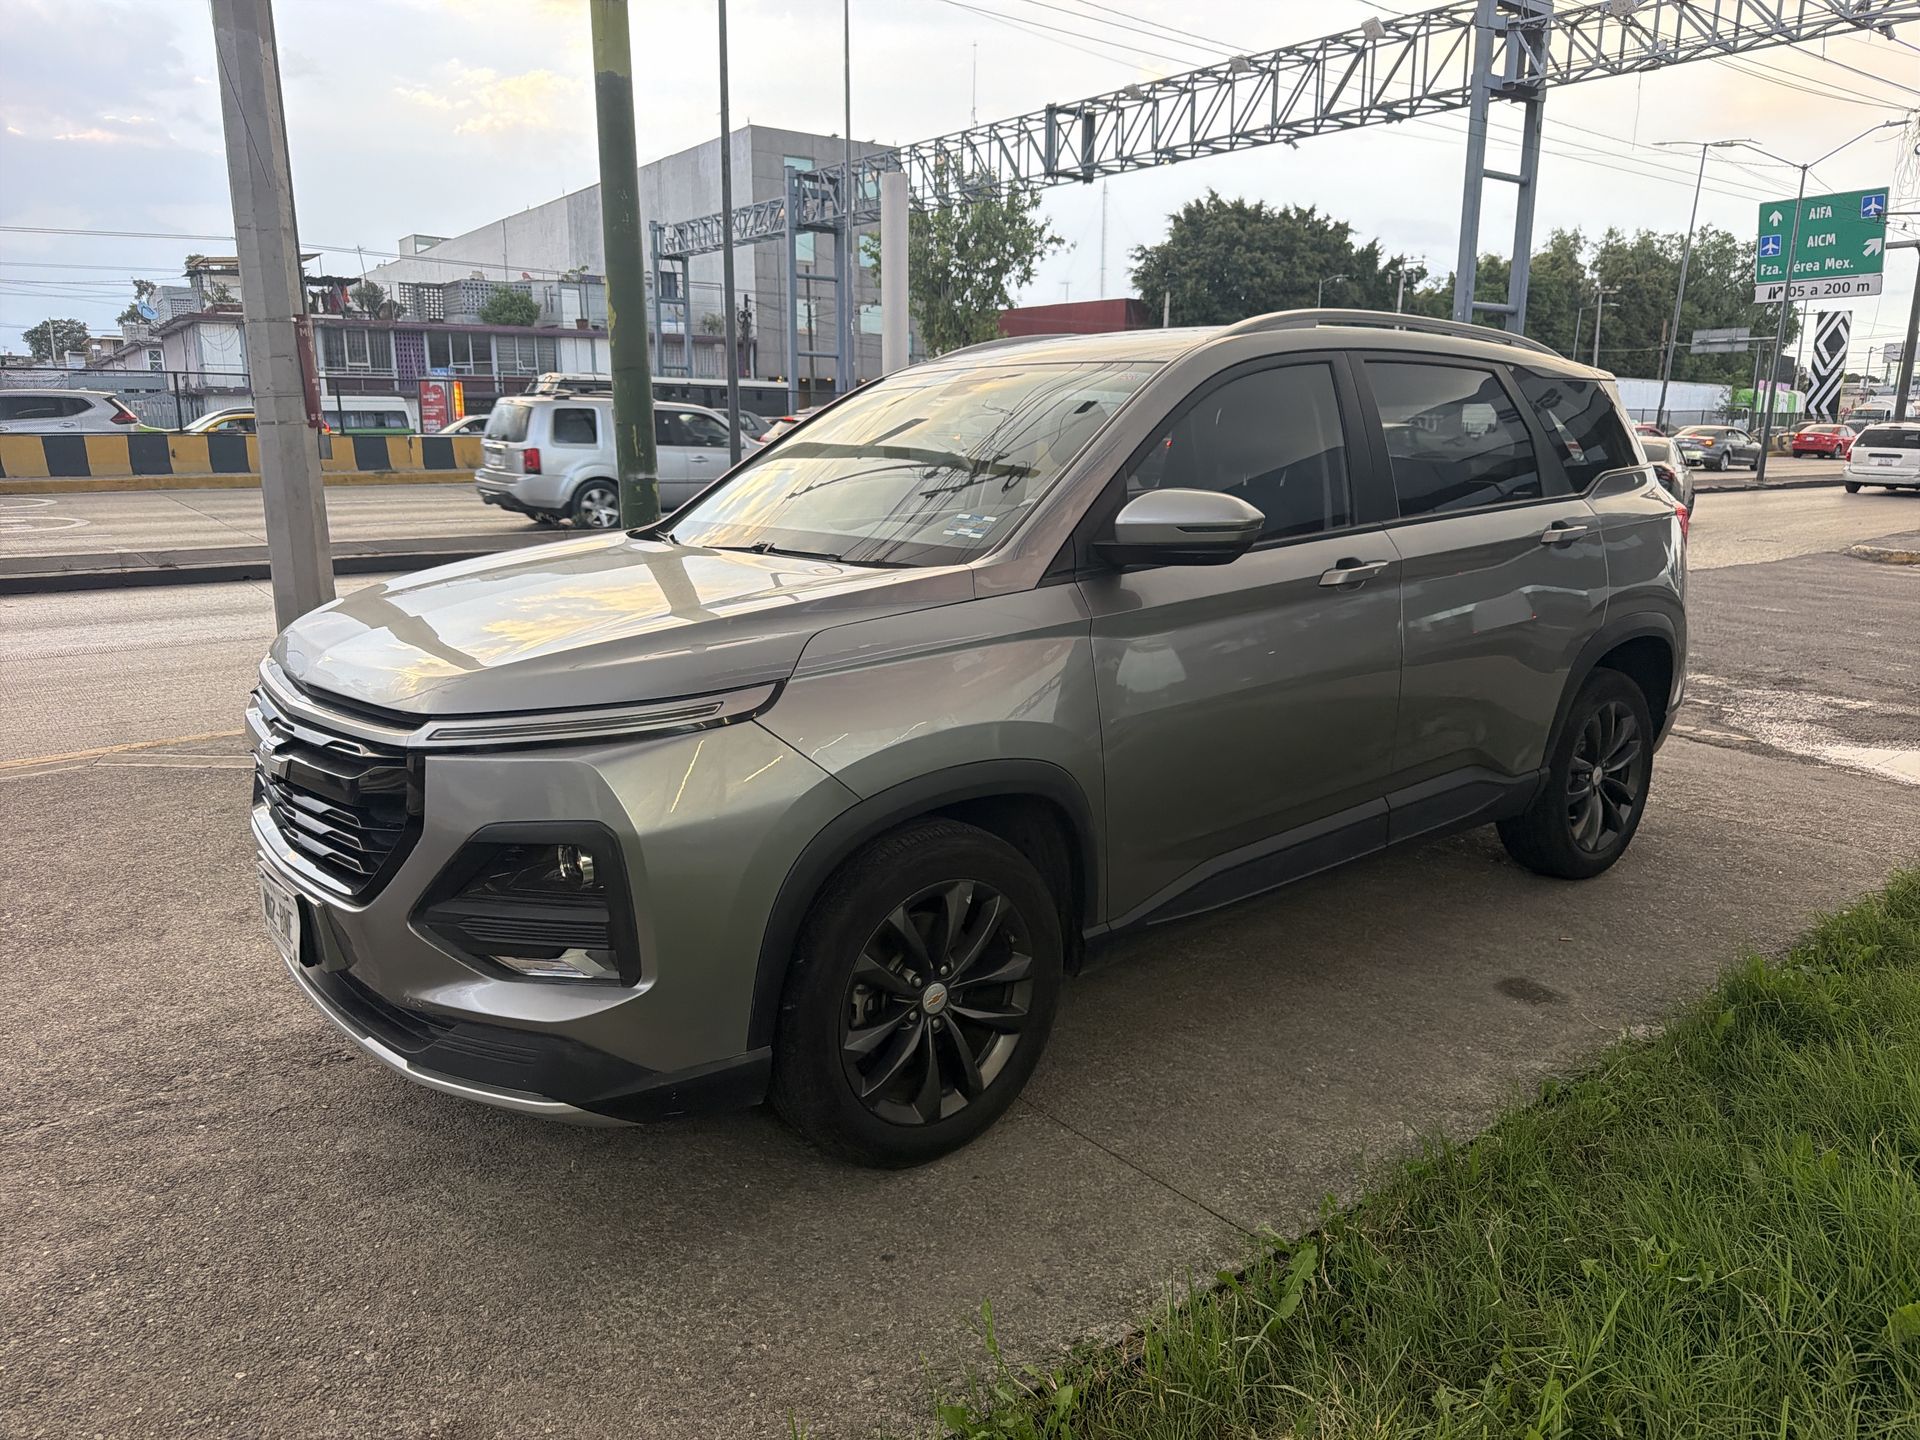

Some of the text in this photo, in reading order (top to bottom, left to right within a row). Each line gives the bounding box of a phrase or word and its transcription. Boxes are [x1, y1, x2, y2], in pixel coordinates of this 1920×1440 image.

[1809, 206, 1832, 220] AIFA
[1807, 233, 1836, 248] AICM
[1760, 257, 1854, 276] Fza. érea Mex.
[1810, 286, 1818, 296] a
[1824, 282, 1851, 295] 200
[1857, 282, 1870, 292] m
